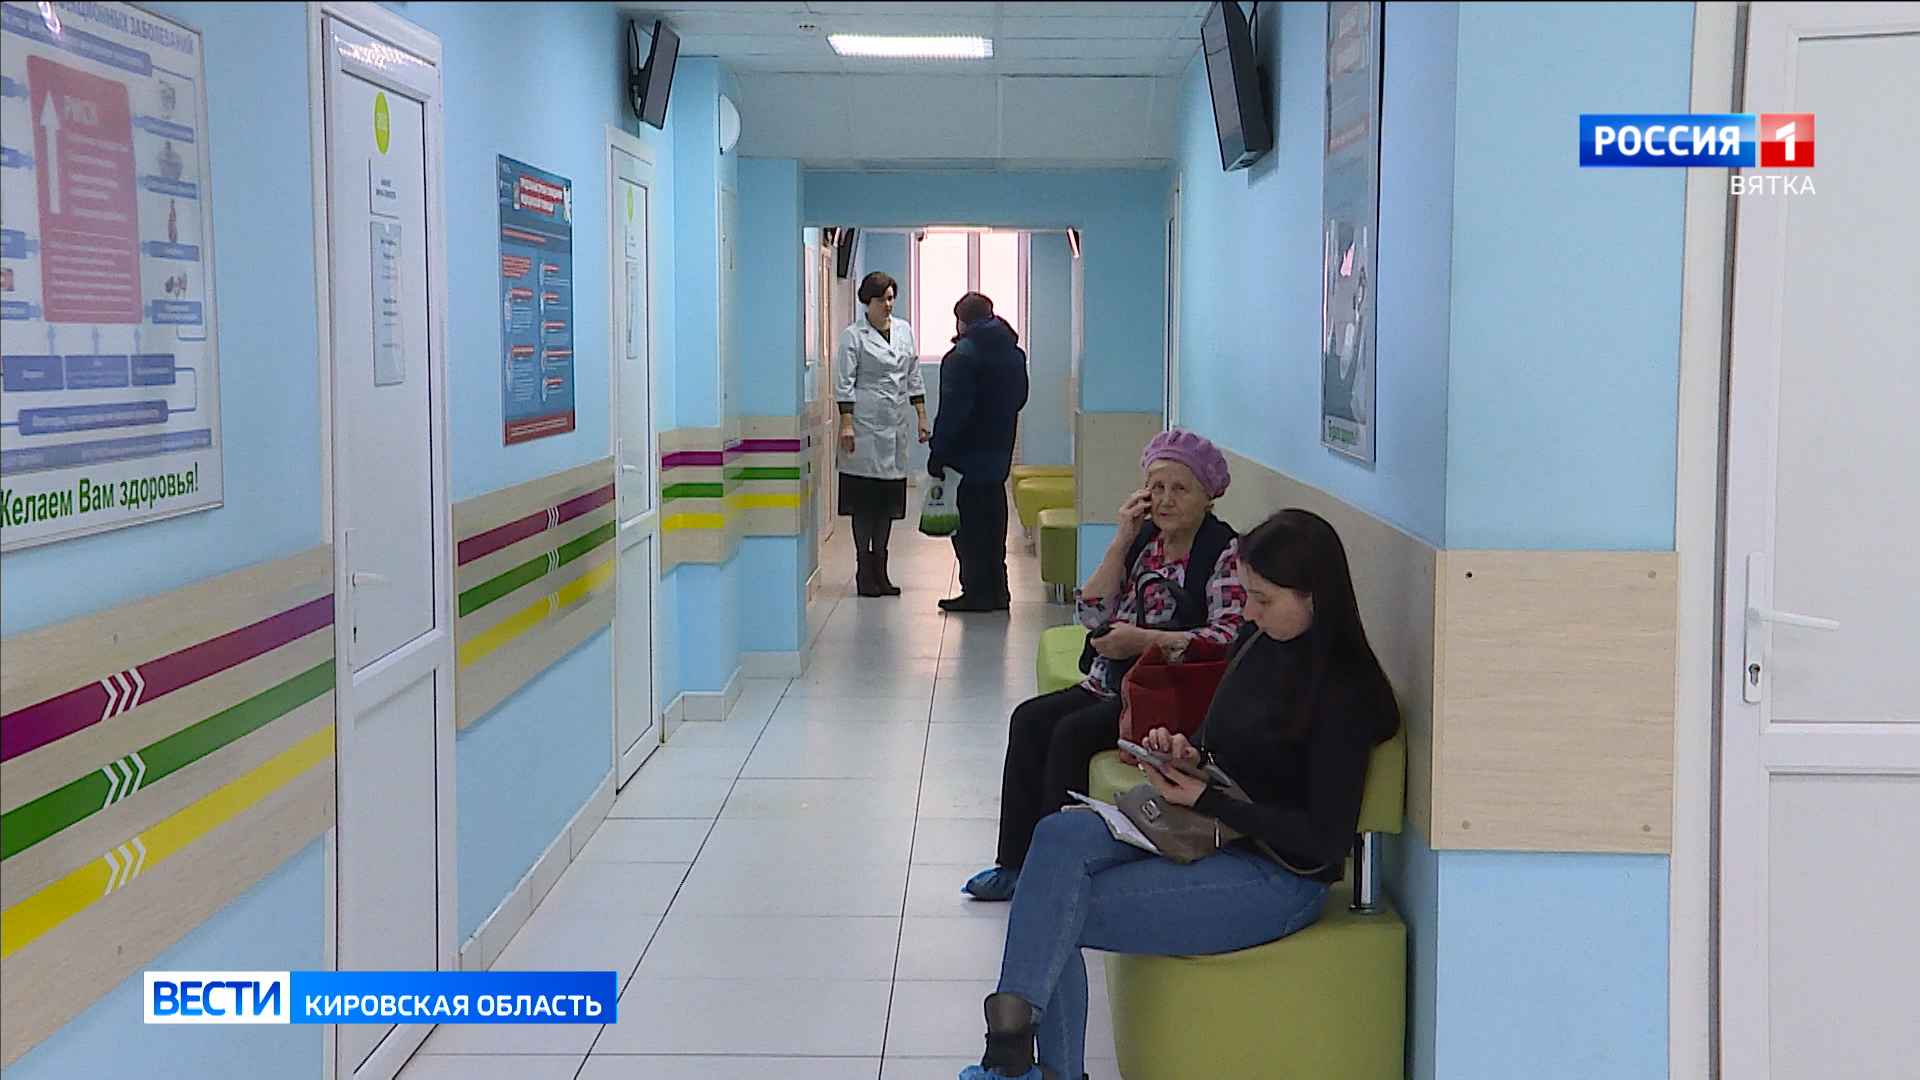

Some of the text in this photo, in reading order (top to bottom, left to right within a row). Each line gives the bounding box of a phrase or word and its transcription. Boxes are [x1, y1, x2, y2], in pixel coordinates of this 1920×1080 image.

[130, 15, 193, 55] ЗАБОЛЕВАНИЙ
[79, 477, 115, 513] Вам
[120, 461, 199, 510] здоровья!
